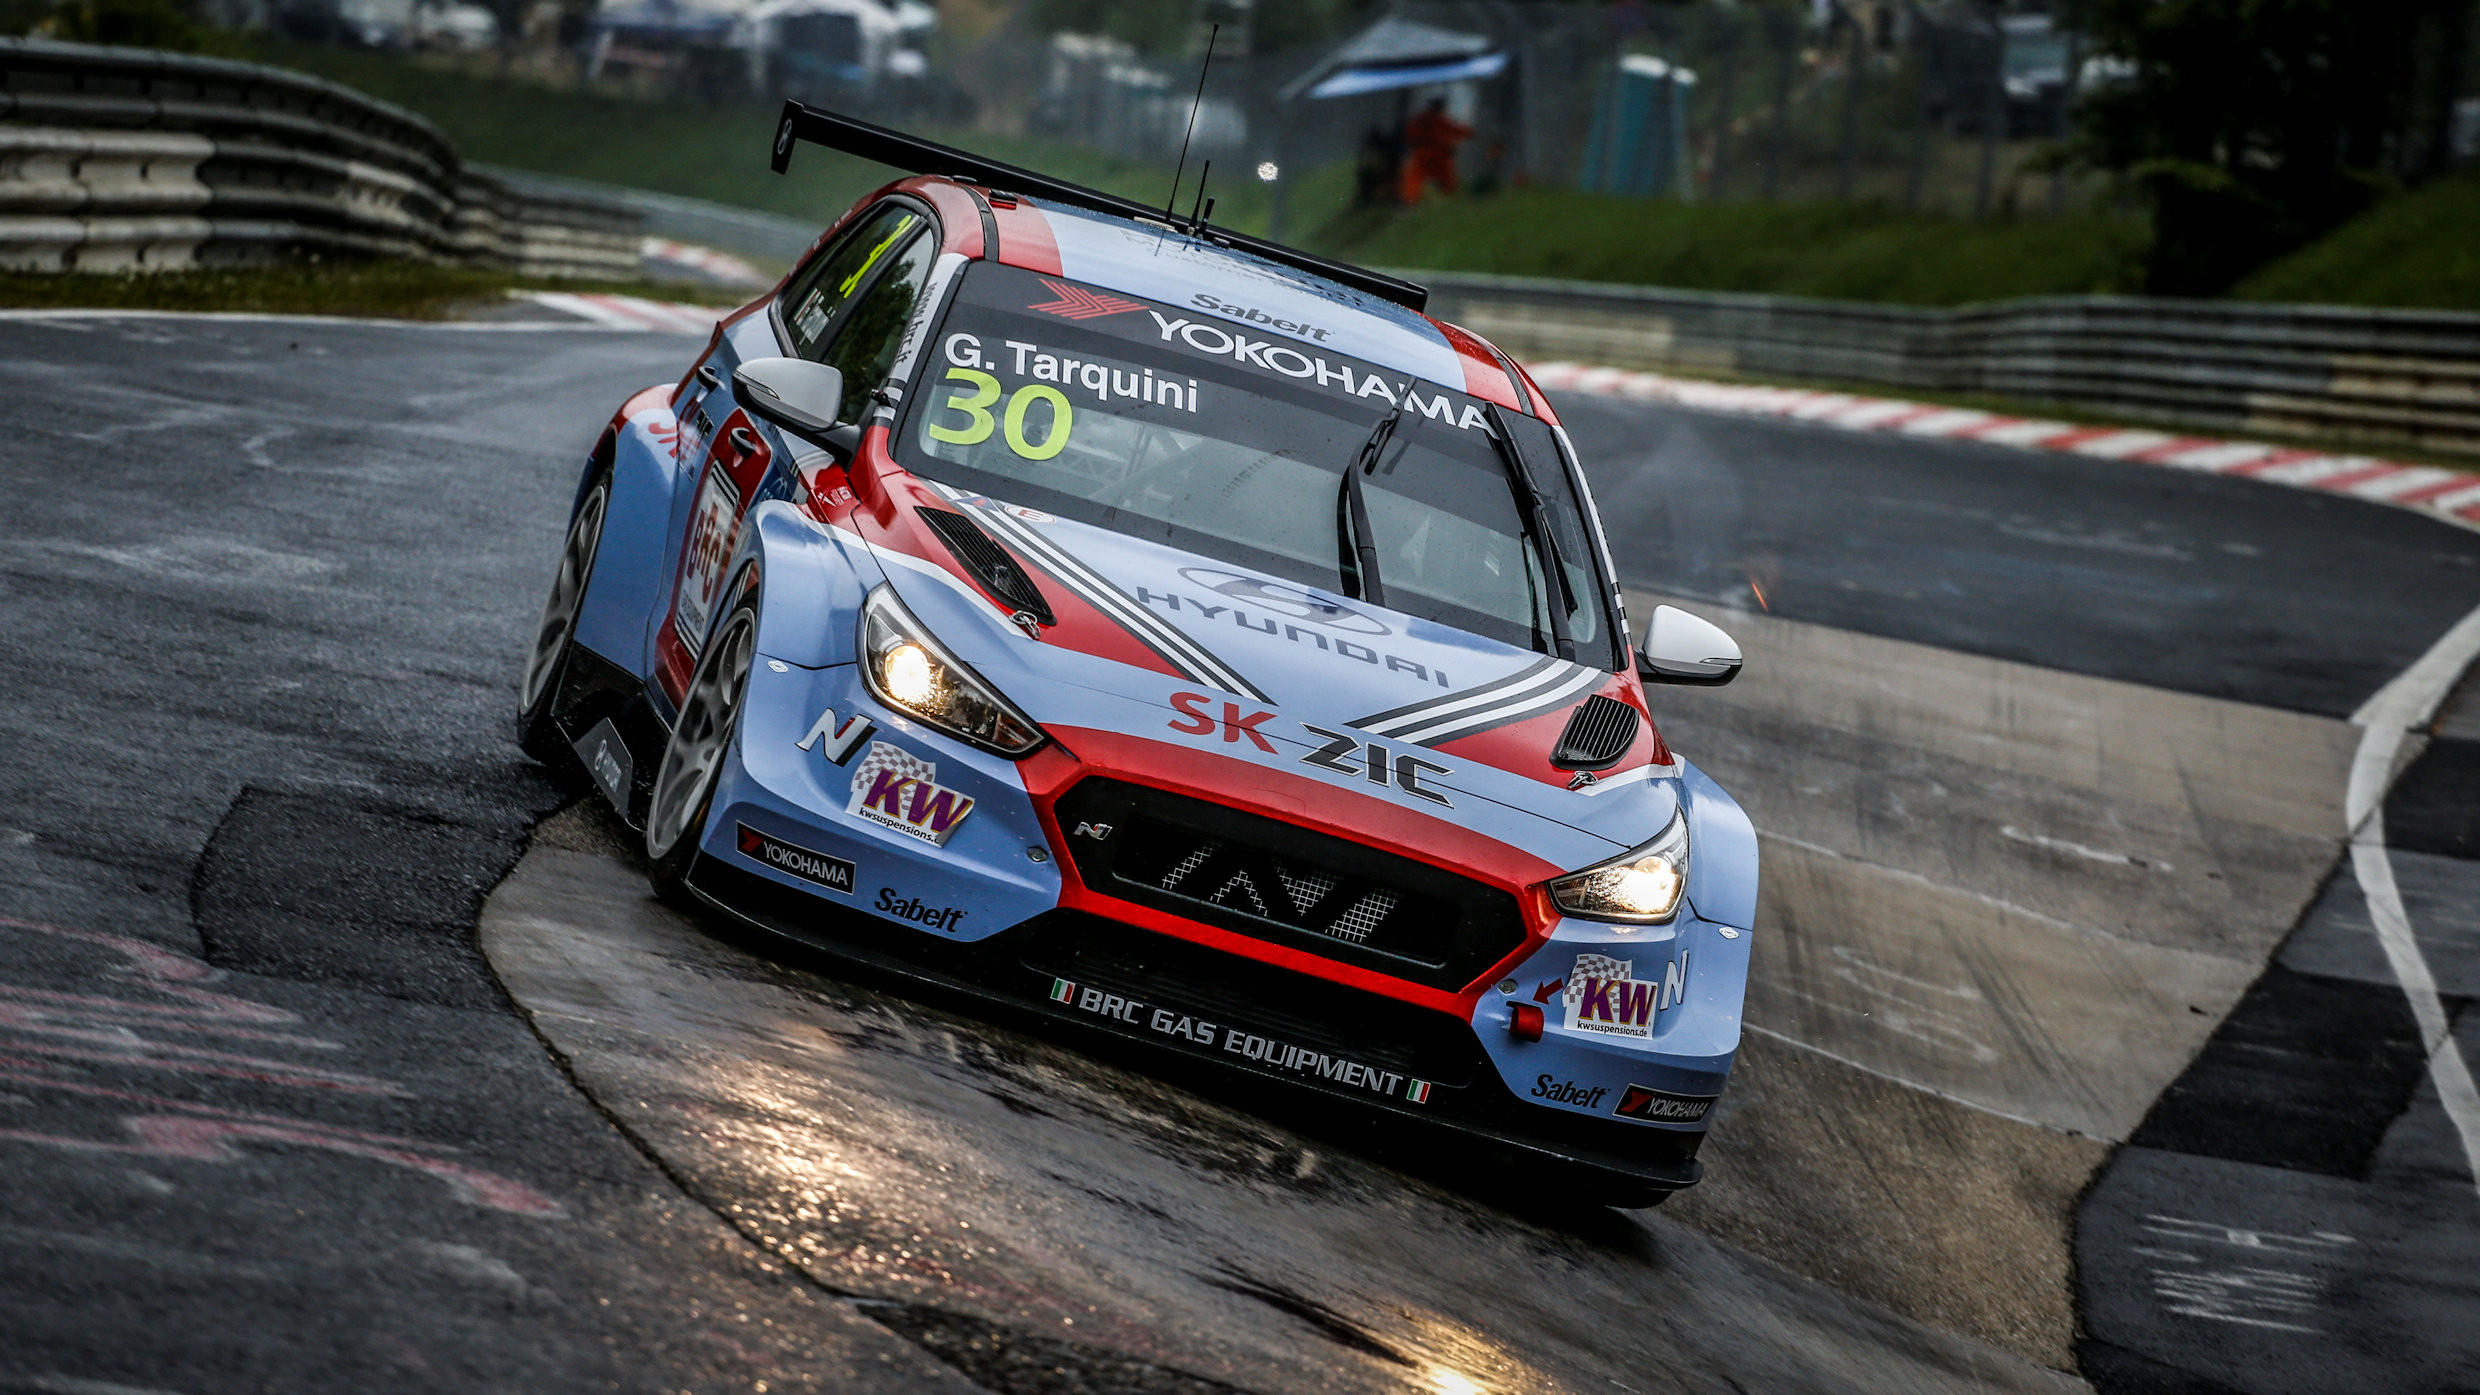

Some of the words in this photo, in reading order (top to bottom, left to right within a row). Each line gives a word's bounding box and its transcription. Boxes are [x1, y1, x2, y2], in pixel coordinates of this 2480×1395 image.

[1190, 293, 1333, 343] Sabelt
[944, 332, 995, 371] G.
[1005, 339, 1198, 414] Tarquini
[1147, 308, 1501, 440] YOKOHAMA
[928, 367, 1074, 462] 30
[1135, 586, 1450, 689] HYUNDAI
[1167, 691, 1280, 755] SK
[1298, 721, 1456, 810] ZIC
[862, 768, 974, 833] KW
[763, 841, 848, 886] YOKOHAMA
[874, 887, 964, 933] Sabelt
[1576, 1020, 1648, 1038] kwsuspensions.de
[1578, 977, 1657, 1027] KW
[1078, 987, 1144, 1025] BRC
[1150, 1008, 1218, 1046] GAS
[1223, 1029, 1404, 1096] EQUIPMENT
[1530, 1073, 1607, 1109] Sabelt
[1646, 1097, 1709, 1119] YOKOHAMA
